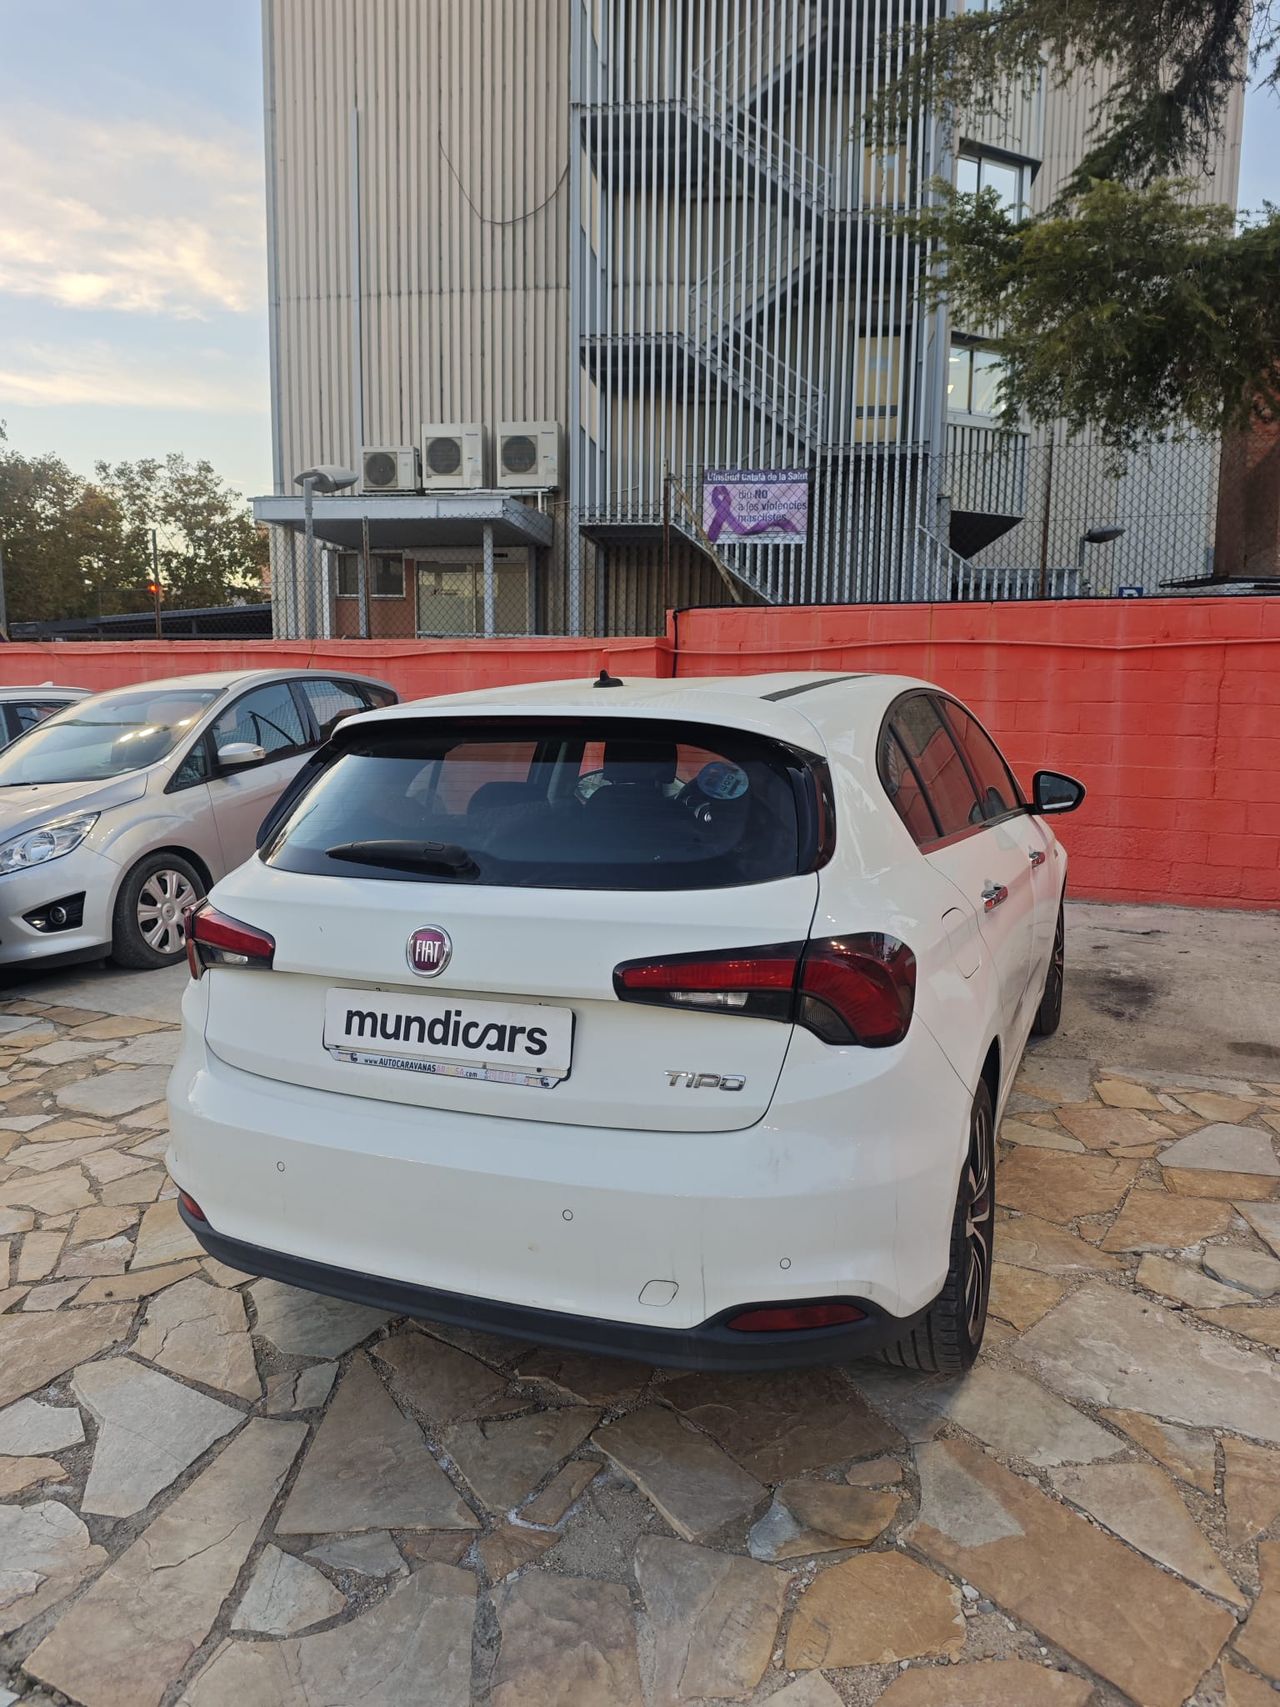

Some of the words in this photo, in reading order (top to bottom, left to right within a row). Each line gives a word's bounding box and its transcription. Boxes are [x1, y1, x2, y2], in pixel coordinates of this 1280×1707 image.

[767, 472, 777, 481] de
[778, 472, 786, 481] la
[787, 471, 808, 481] Salut
[754, 489, 768, 499] NO
[738, 503, 744, 511] a
[746, 501, 759, 511] les
[738, 513, 787, 523] masclistes
[415, 940, 441, 963] FIAT
[345, 1009, 548, 1056] mundicars
[664, 1070, 747, 1091] TIPO
